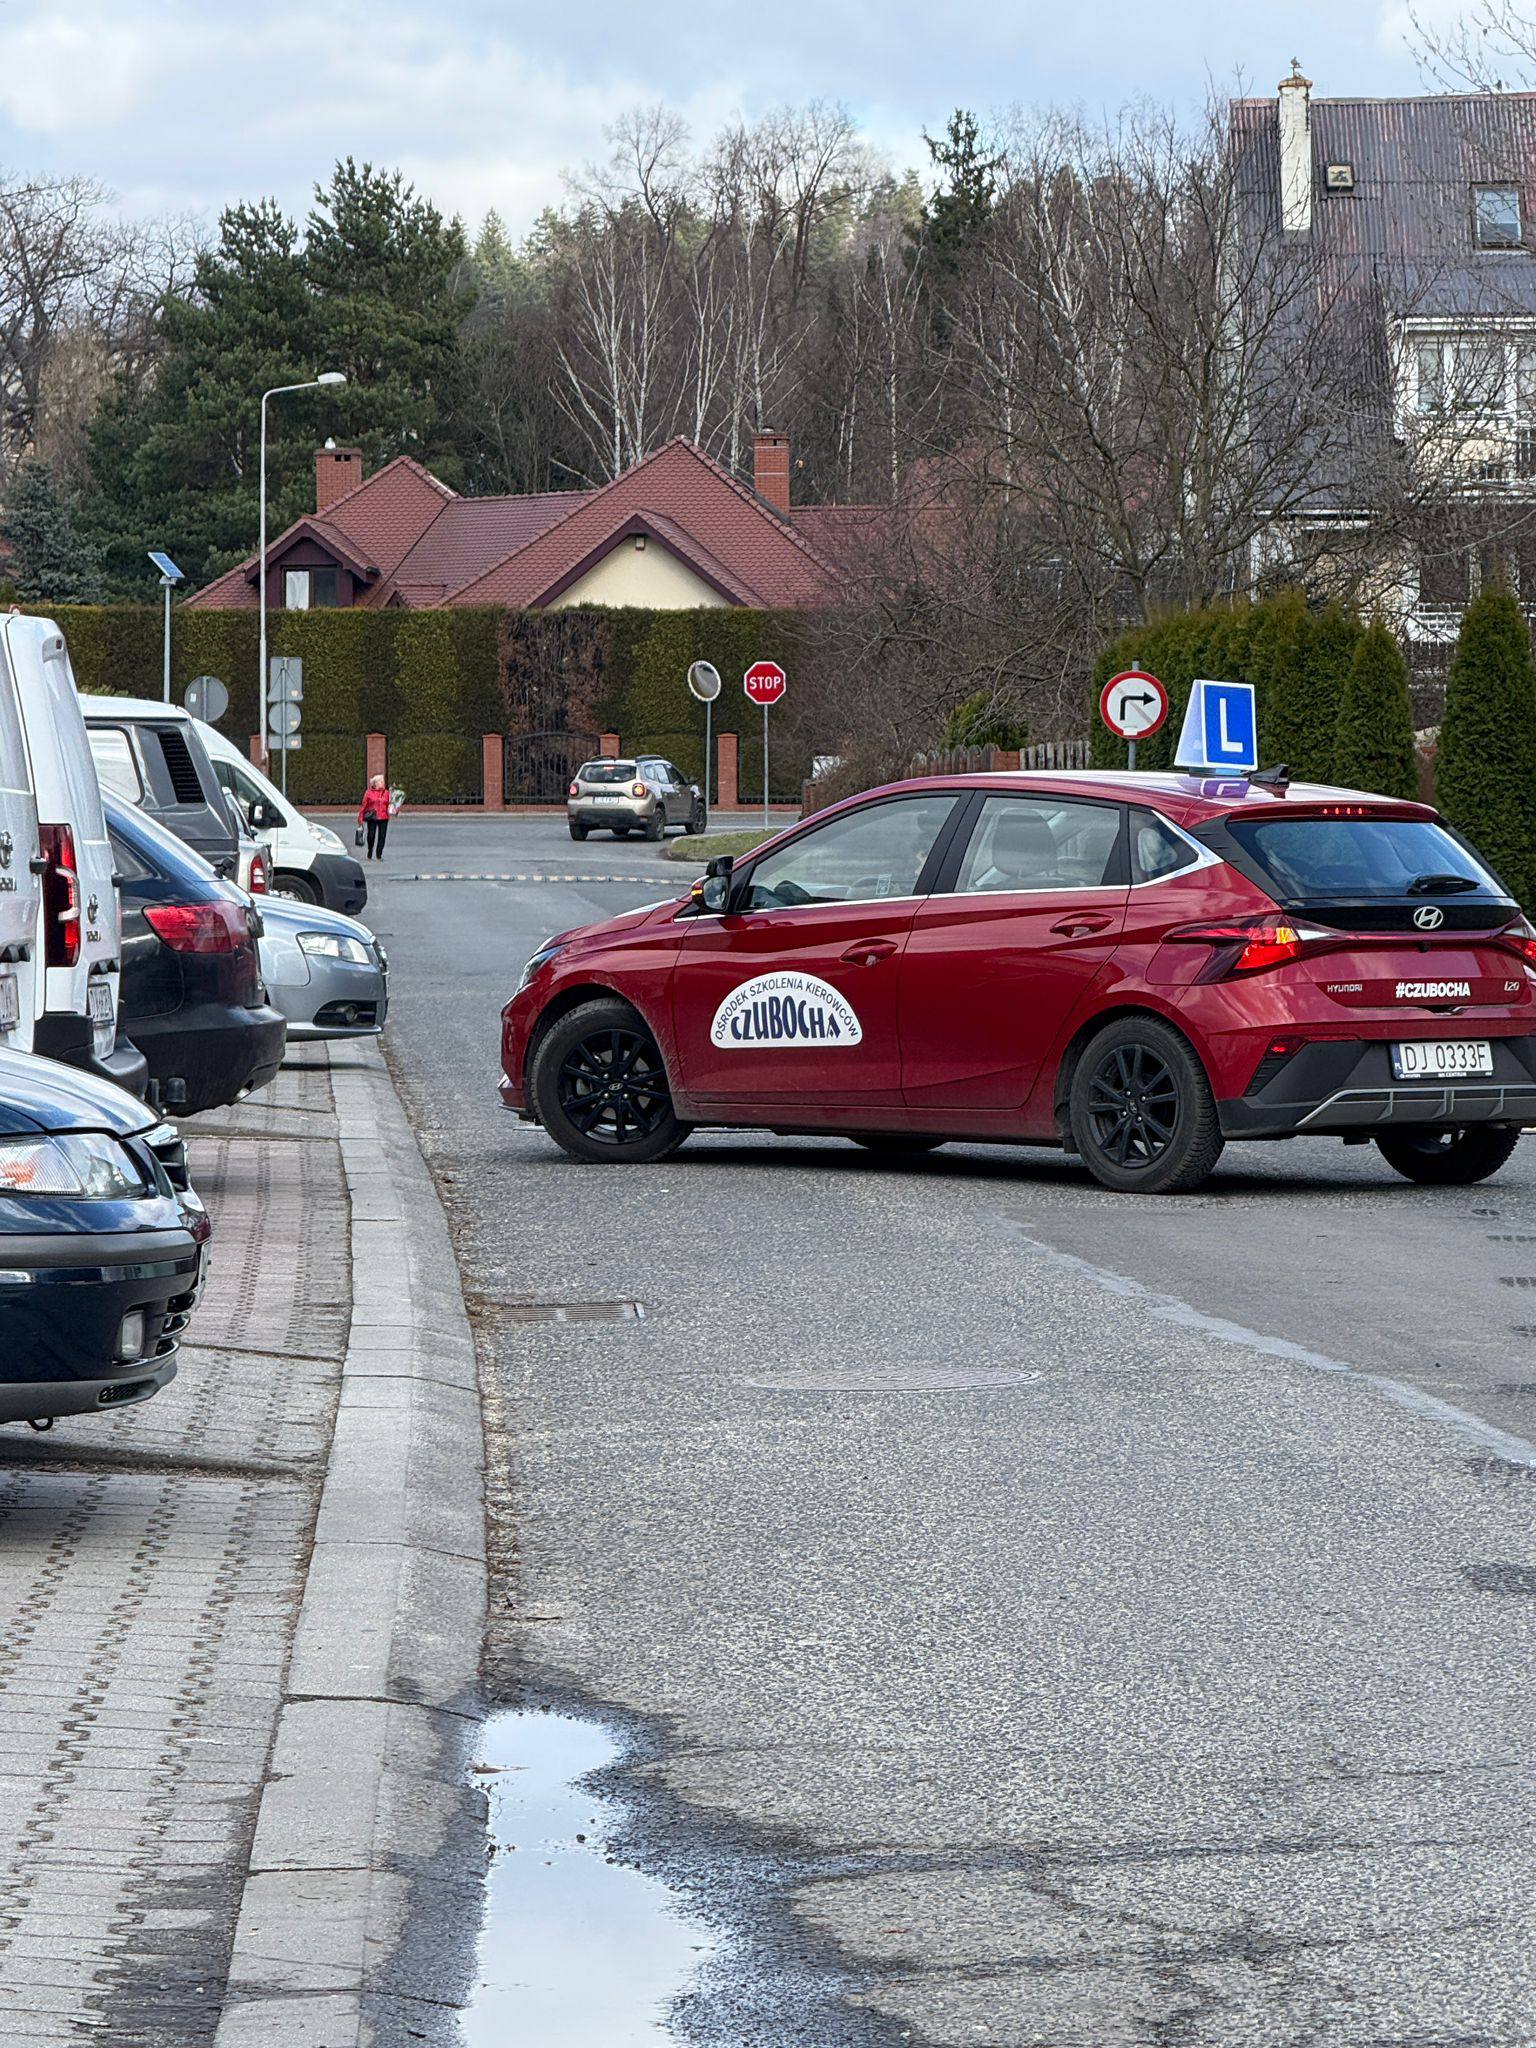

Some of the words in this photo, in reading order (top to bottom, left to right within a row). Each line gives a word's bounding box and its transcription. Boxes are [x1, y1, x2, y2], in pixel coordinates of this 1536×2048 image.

[749, 676, 781, 690] STOP
[1219, 698, 1243, 752] L
[1327, 983, 1363, 993] HYUNDAI
[1395, 982, 1470, 998] #CZUBOCHA
[715, 990, 749, 1040] OŚRODEK
[750, 977, 803, 996] SZKOLENIA
[805, 981, 859, 1037] KIEROWCÓW
[730, 995, 841, 1041] CZUBOCHA
[1404, 1045, 1428, 1071] DJ
[1435, 1043, 1486, 1070] 0333F
